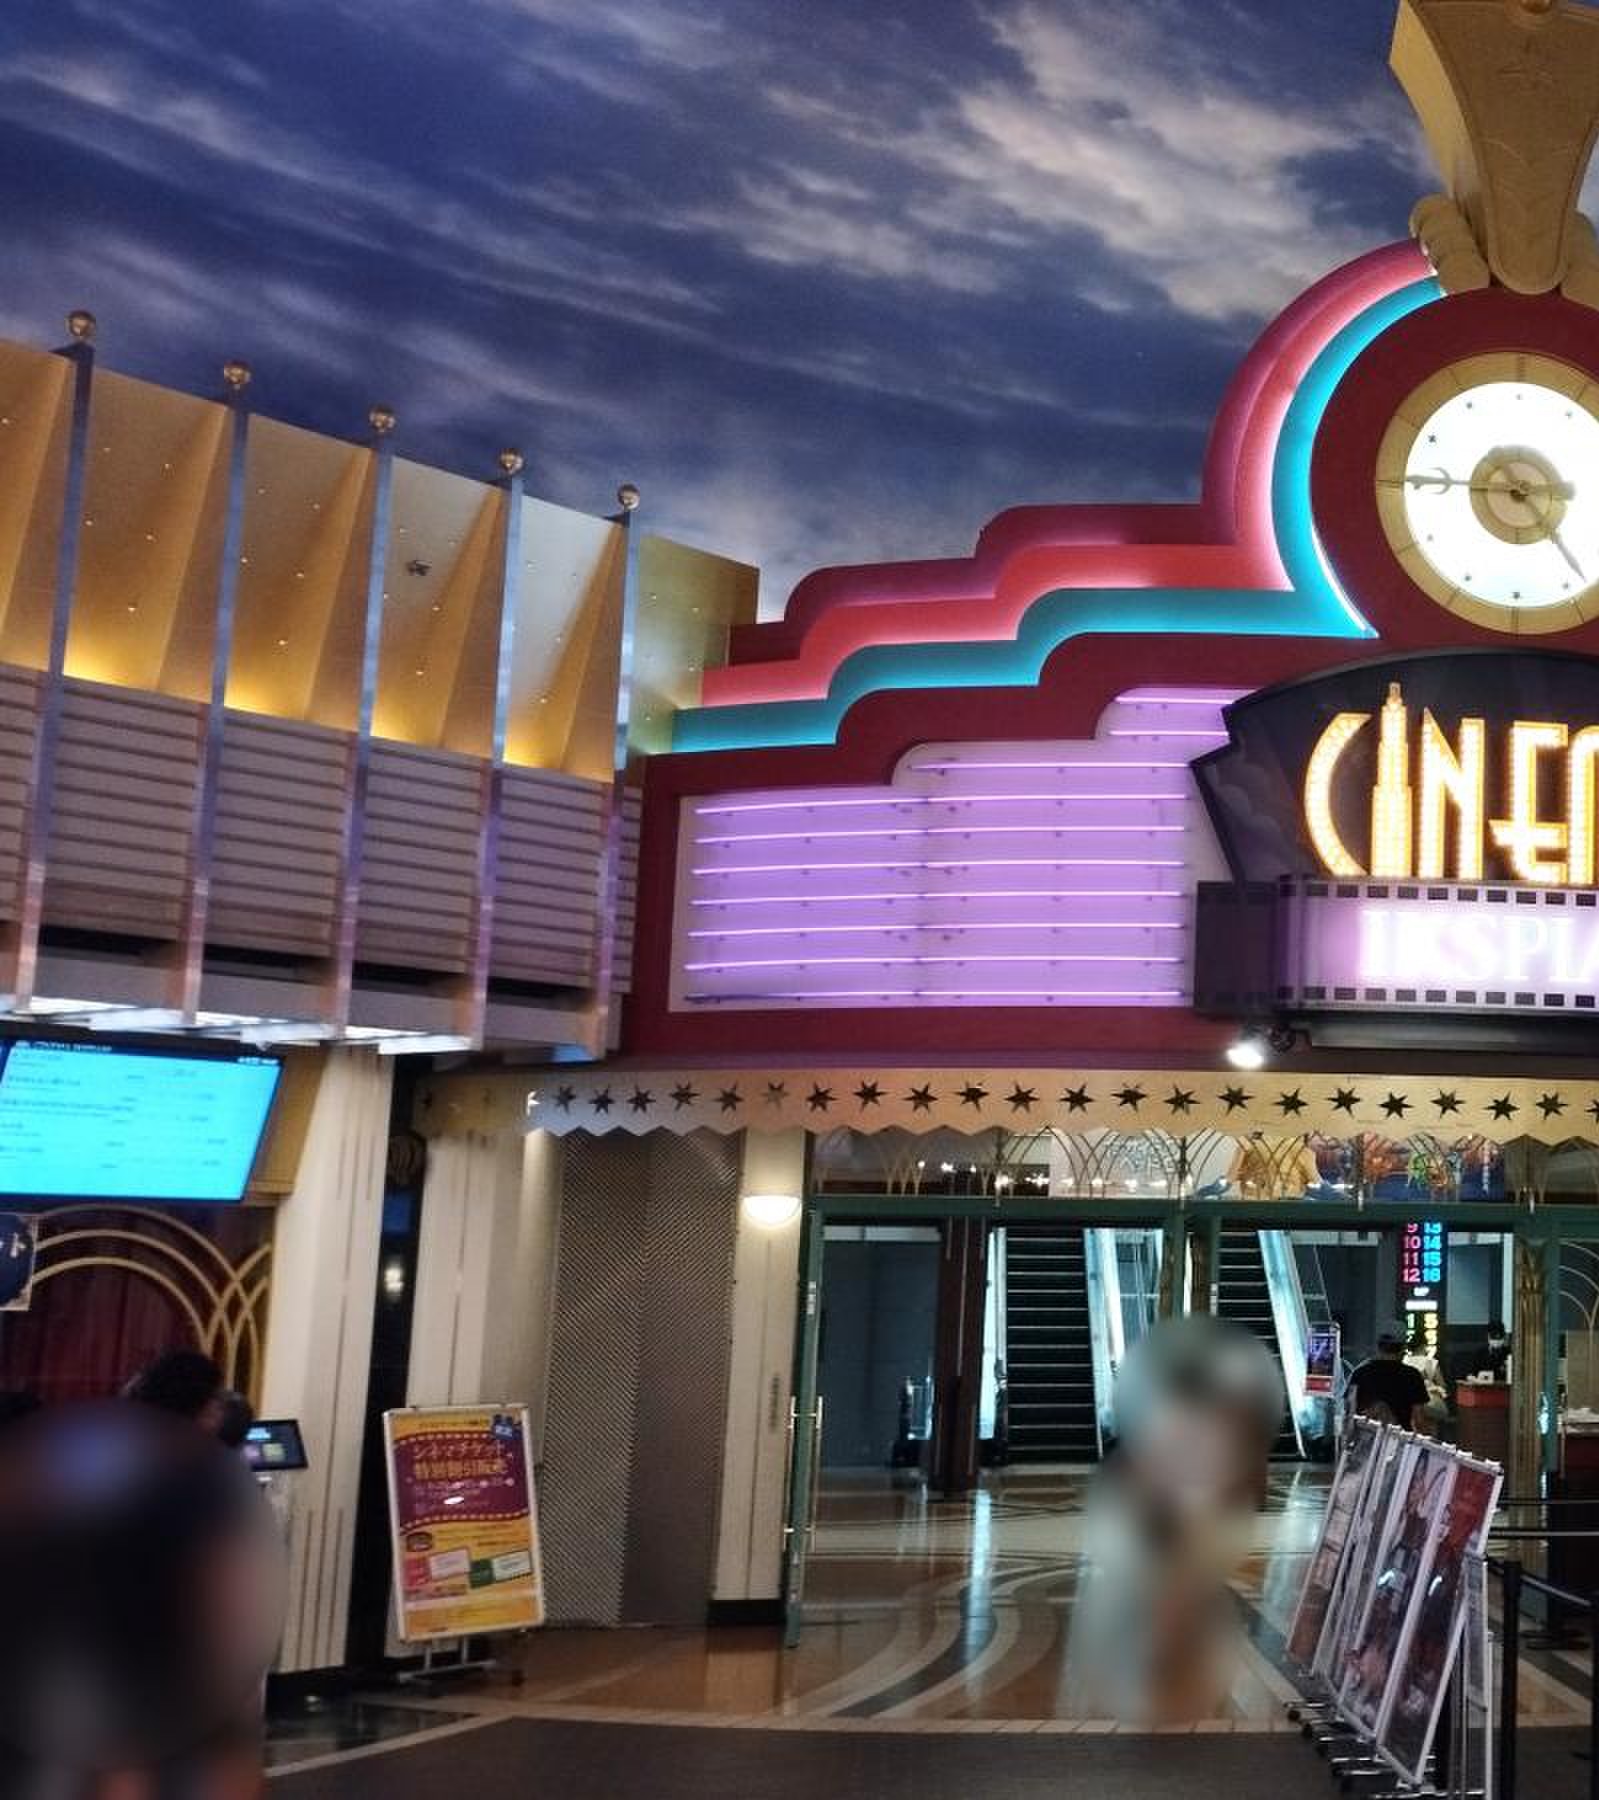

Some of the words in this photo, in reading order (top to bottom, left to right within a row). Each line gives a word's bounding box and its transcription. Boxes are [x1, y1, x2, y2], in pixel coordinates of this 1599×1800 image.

[1403, 1235, 1421, 1249] 10
[1423, 1235, 1442, 1250] 14
[1403, 1251, 1419, 1265] 11
[1402, 1267, 1421, 1282] 12
